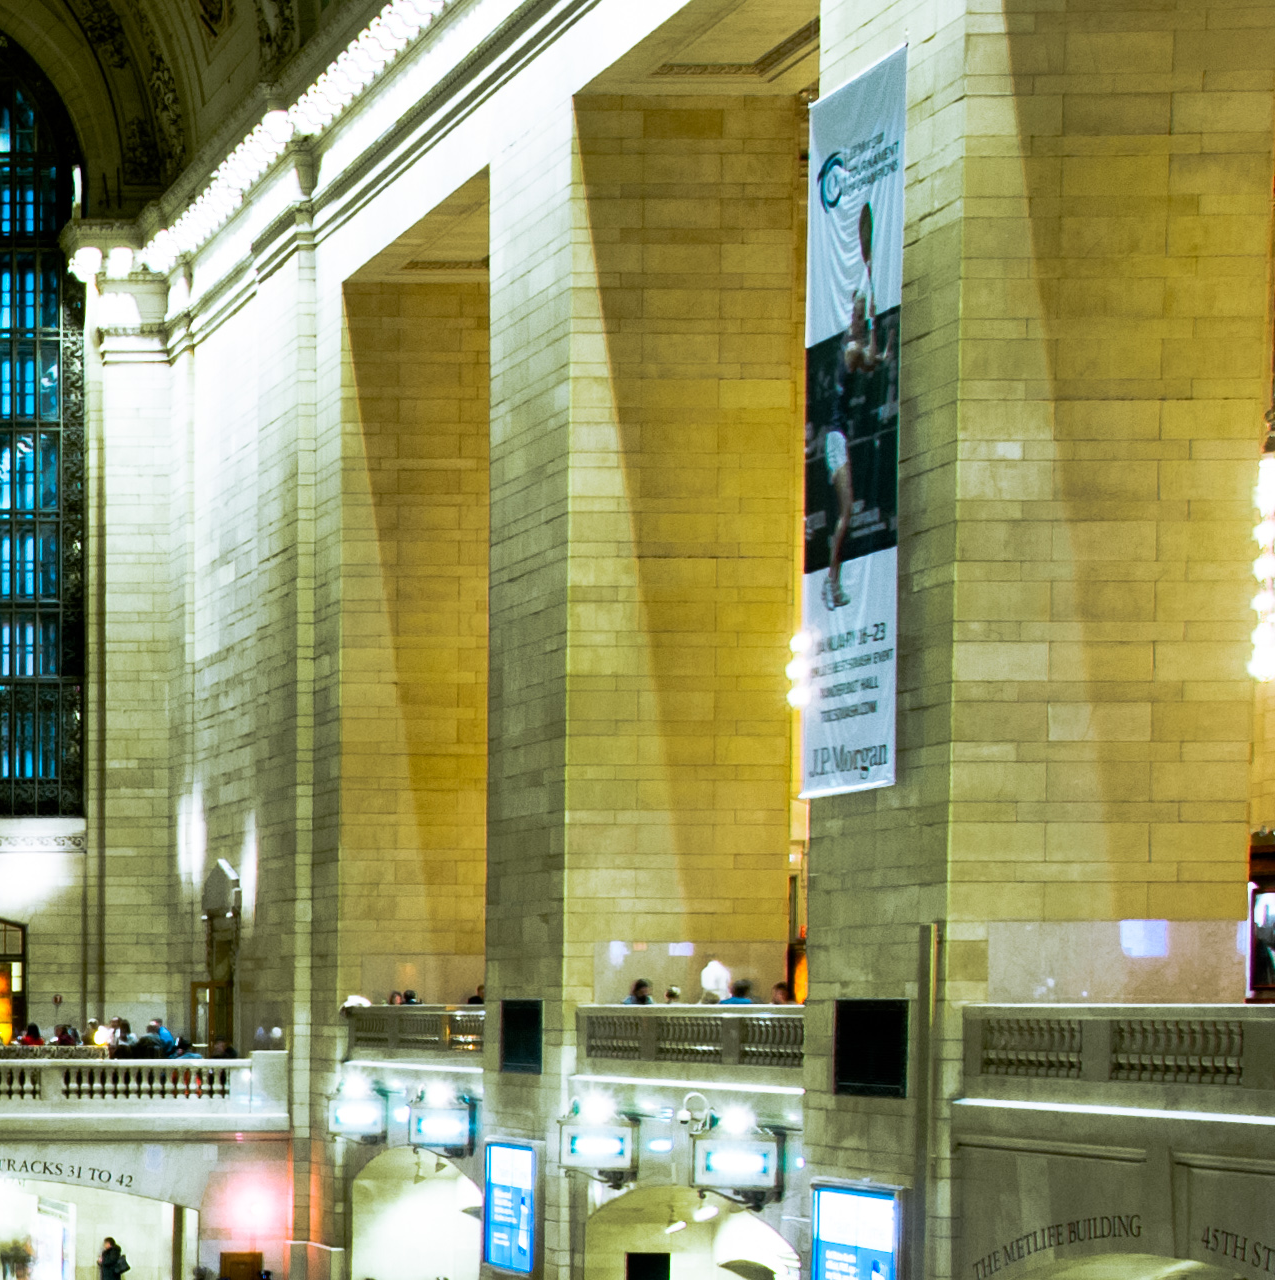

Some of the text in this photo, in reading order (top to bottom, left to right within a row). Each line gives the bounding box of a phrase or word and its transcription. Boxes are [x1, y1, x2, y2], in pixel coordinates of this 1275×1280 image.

[67, 1165, 82, 1179] 31
[88, 1167, 112, 1184] TO
[116, 1173, 134, 1188] 42
[1002, 1223, 1064, 1266] METLIFE
[1067, 1214, 1142, 1244] BUILDING
[1201, 1226, 1249, 1262] 45TH
